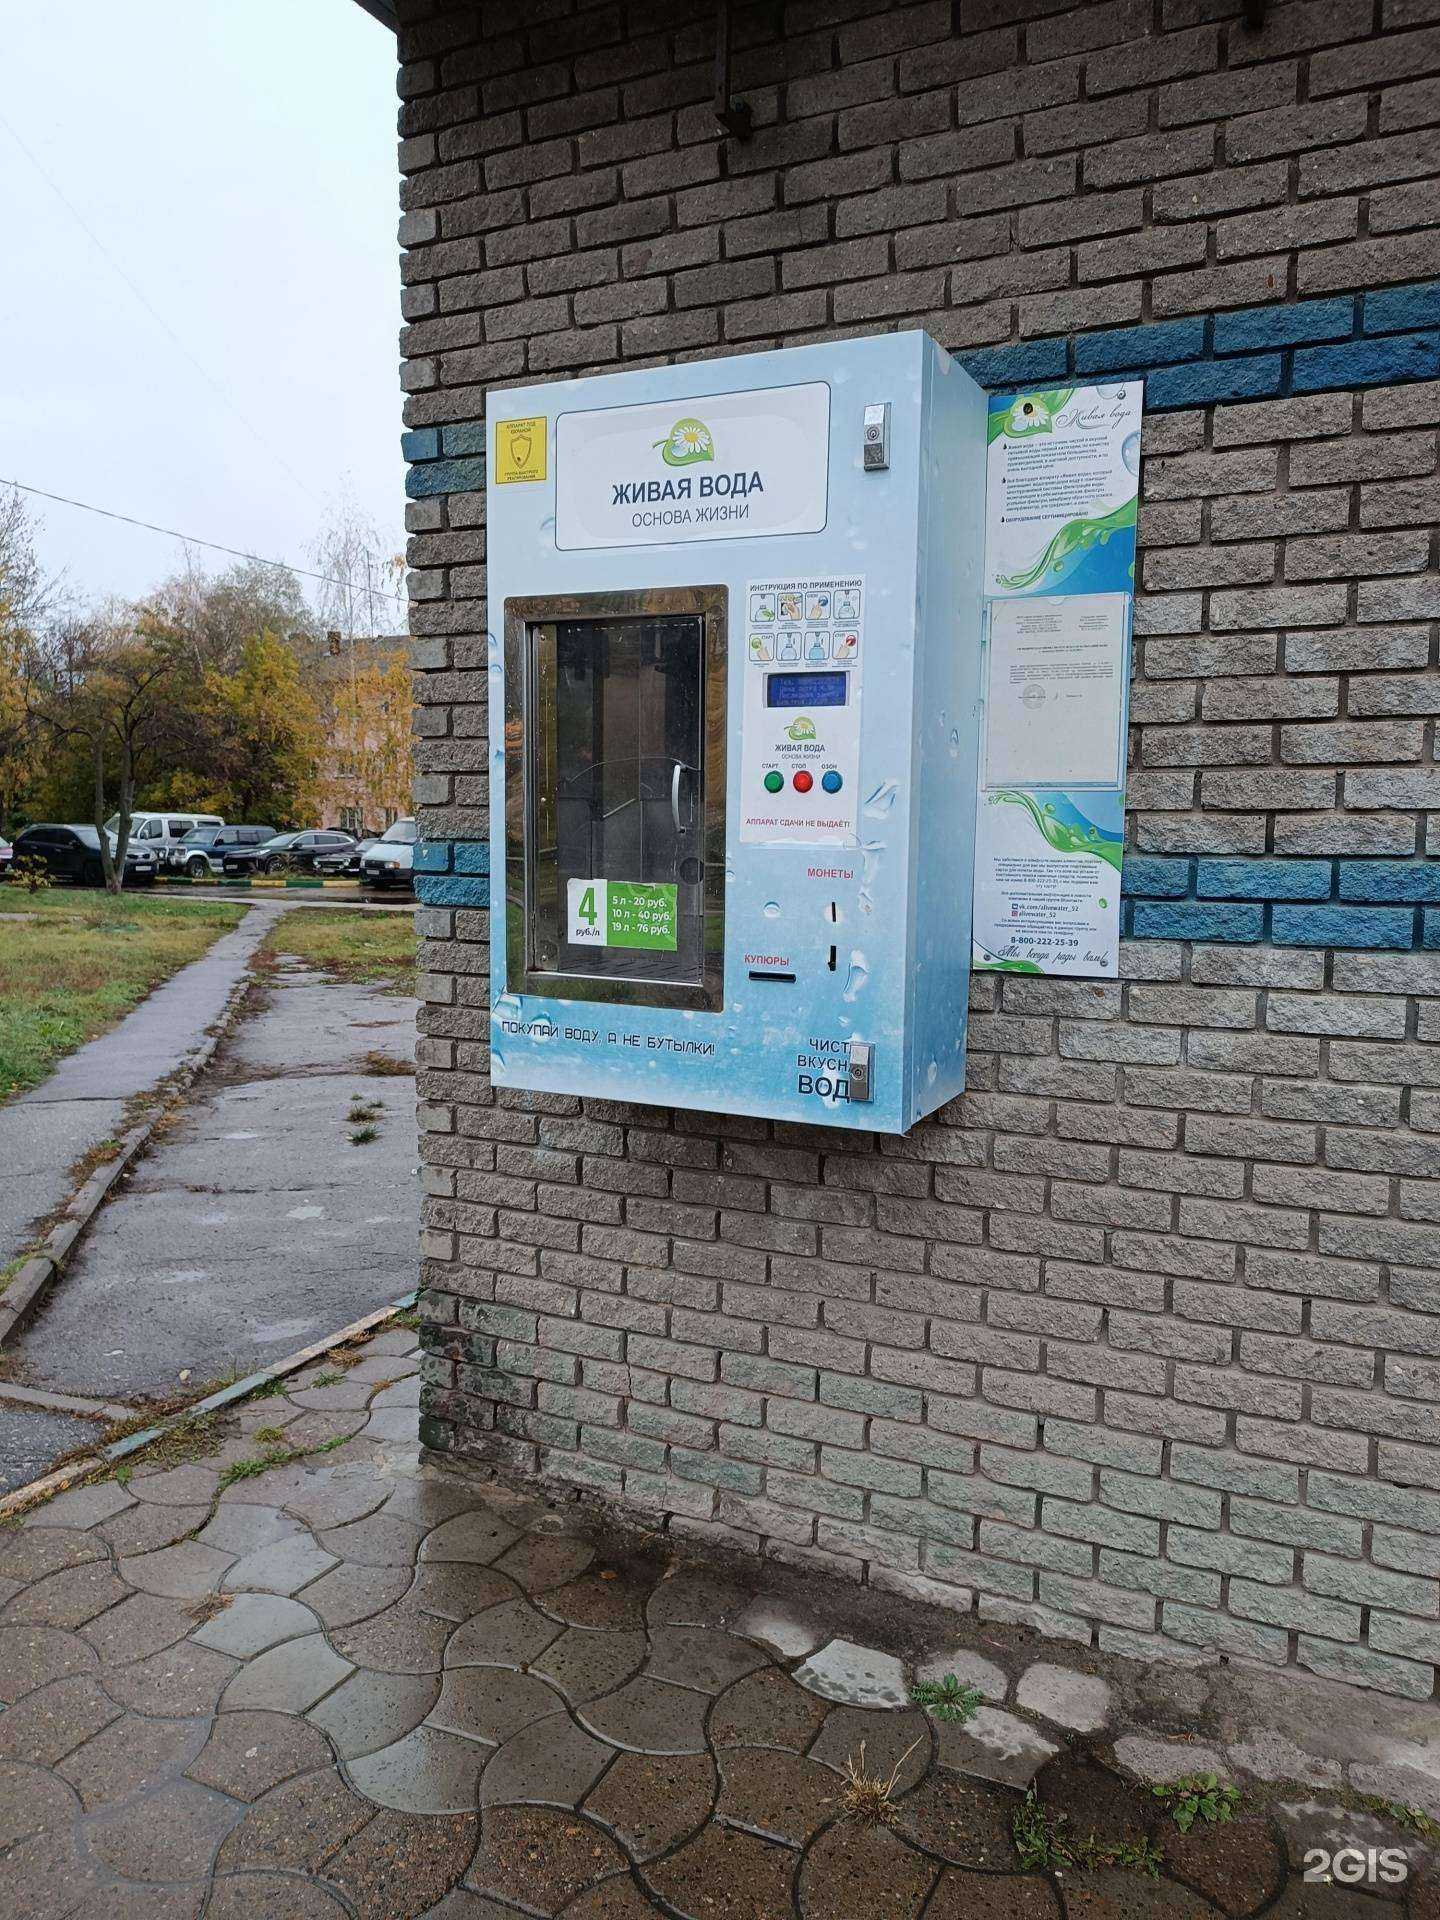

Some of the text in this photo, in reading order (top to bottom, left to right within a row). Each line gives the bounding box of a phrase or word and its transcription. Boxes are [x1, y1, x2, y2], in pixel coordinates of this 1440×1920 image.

[612, 471, 764, 505] ЖИВАЯ ВОДА
[632, 503, 749, 528] ОСНОВА ЖИЗНИ
[750, 580, 862, 592] ИНСТРУКЦИЯ ПО ПРИМЕНЕНИЮ
[774, 744, 826, 753] ЖИВАЯ ВОДА
[746, 818, 779, 826] АППАРАТ
[780, 818, 804, 827] СДАЧИ
[805, 819, 816, 827] НЕ
[807, 868, 854, 879] МОНЕТЫ
[578, 887, 598, 926] 4
[612, 895, 618, 904] 5
[620, 897, 626, 905] л
[633, 896, 645, 905] 20
[647, 898, 667, 909] руб.
[612, 908, 622, 918] 10
[624, 910, 630, 918] л
[638, 910, 650, 919] 40
[652, 911, 672, 922] руб.
[576, 926, 600, 937] руб./л
[612, 922, 622, 931] 19
[624, 924, 630, 932] л
[637, 923, 649, 933] 76
[650, 925, 671, 936] руб.
[1011, 936, 1079, 946] 8-800-222-25-39
[744, 954, 789, 966] КУПЮРЫ
[501, 1020, 715, 1056] ПОКУПАЙ ВОДУ, А НЕ БУТЫЛКИ!
[809, 1038, 851, 1054] ЧИСТ
[797, 1054, 851, 1073] ВКУСН
[798, 1074, 851, 1103] ВОД
